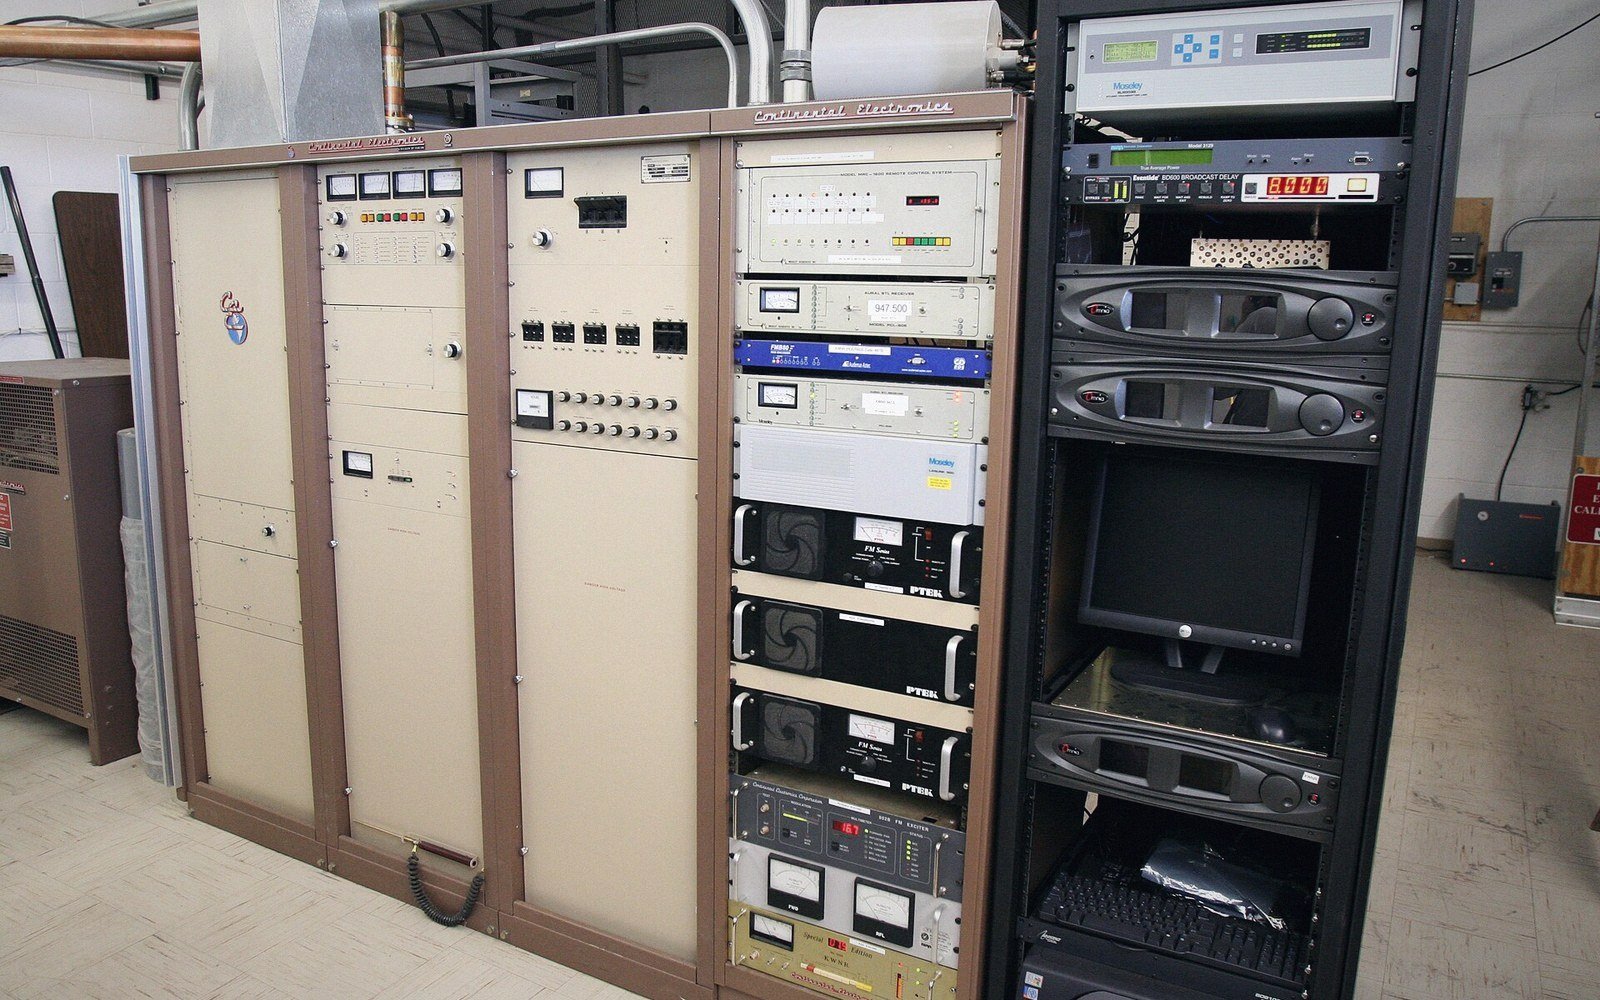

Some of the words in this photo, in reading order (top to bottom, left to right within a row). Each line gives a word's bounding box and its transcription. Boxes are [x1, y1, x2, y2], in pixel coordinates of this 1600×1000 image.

[1113, 82, 1143, 91] Moseley
[754, 106, 847, 122] Continental
[856, 101, 955, 117] Electronics
[309, 140, 363, 152] Continental
[369, 136, 424, 147] Electronics
[875, 304, 908, 313] 947.500
[929, 458, 954, 468] Moseley
[910, 586, 943, 598] PTEK
[906, 685, 938, 699] PTEK
[902, 782, 934, 797] PTEK
[851, 816, 872, 824] MULTIMETER
[906, 823, 929, 832] EXCITER
[803, 932, 823, 943] Special
[851, 947, 873, 959] Edition
